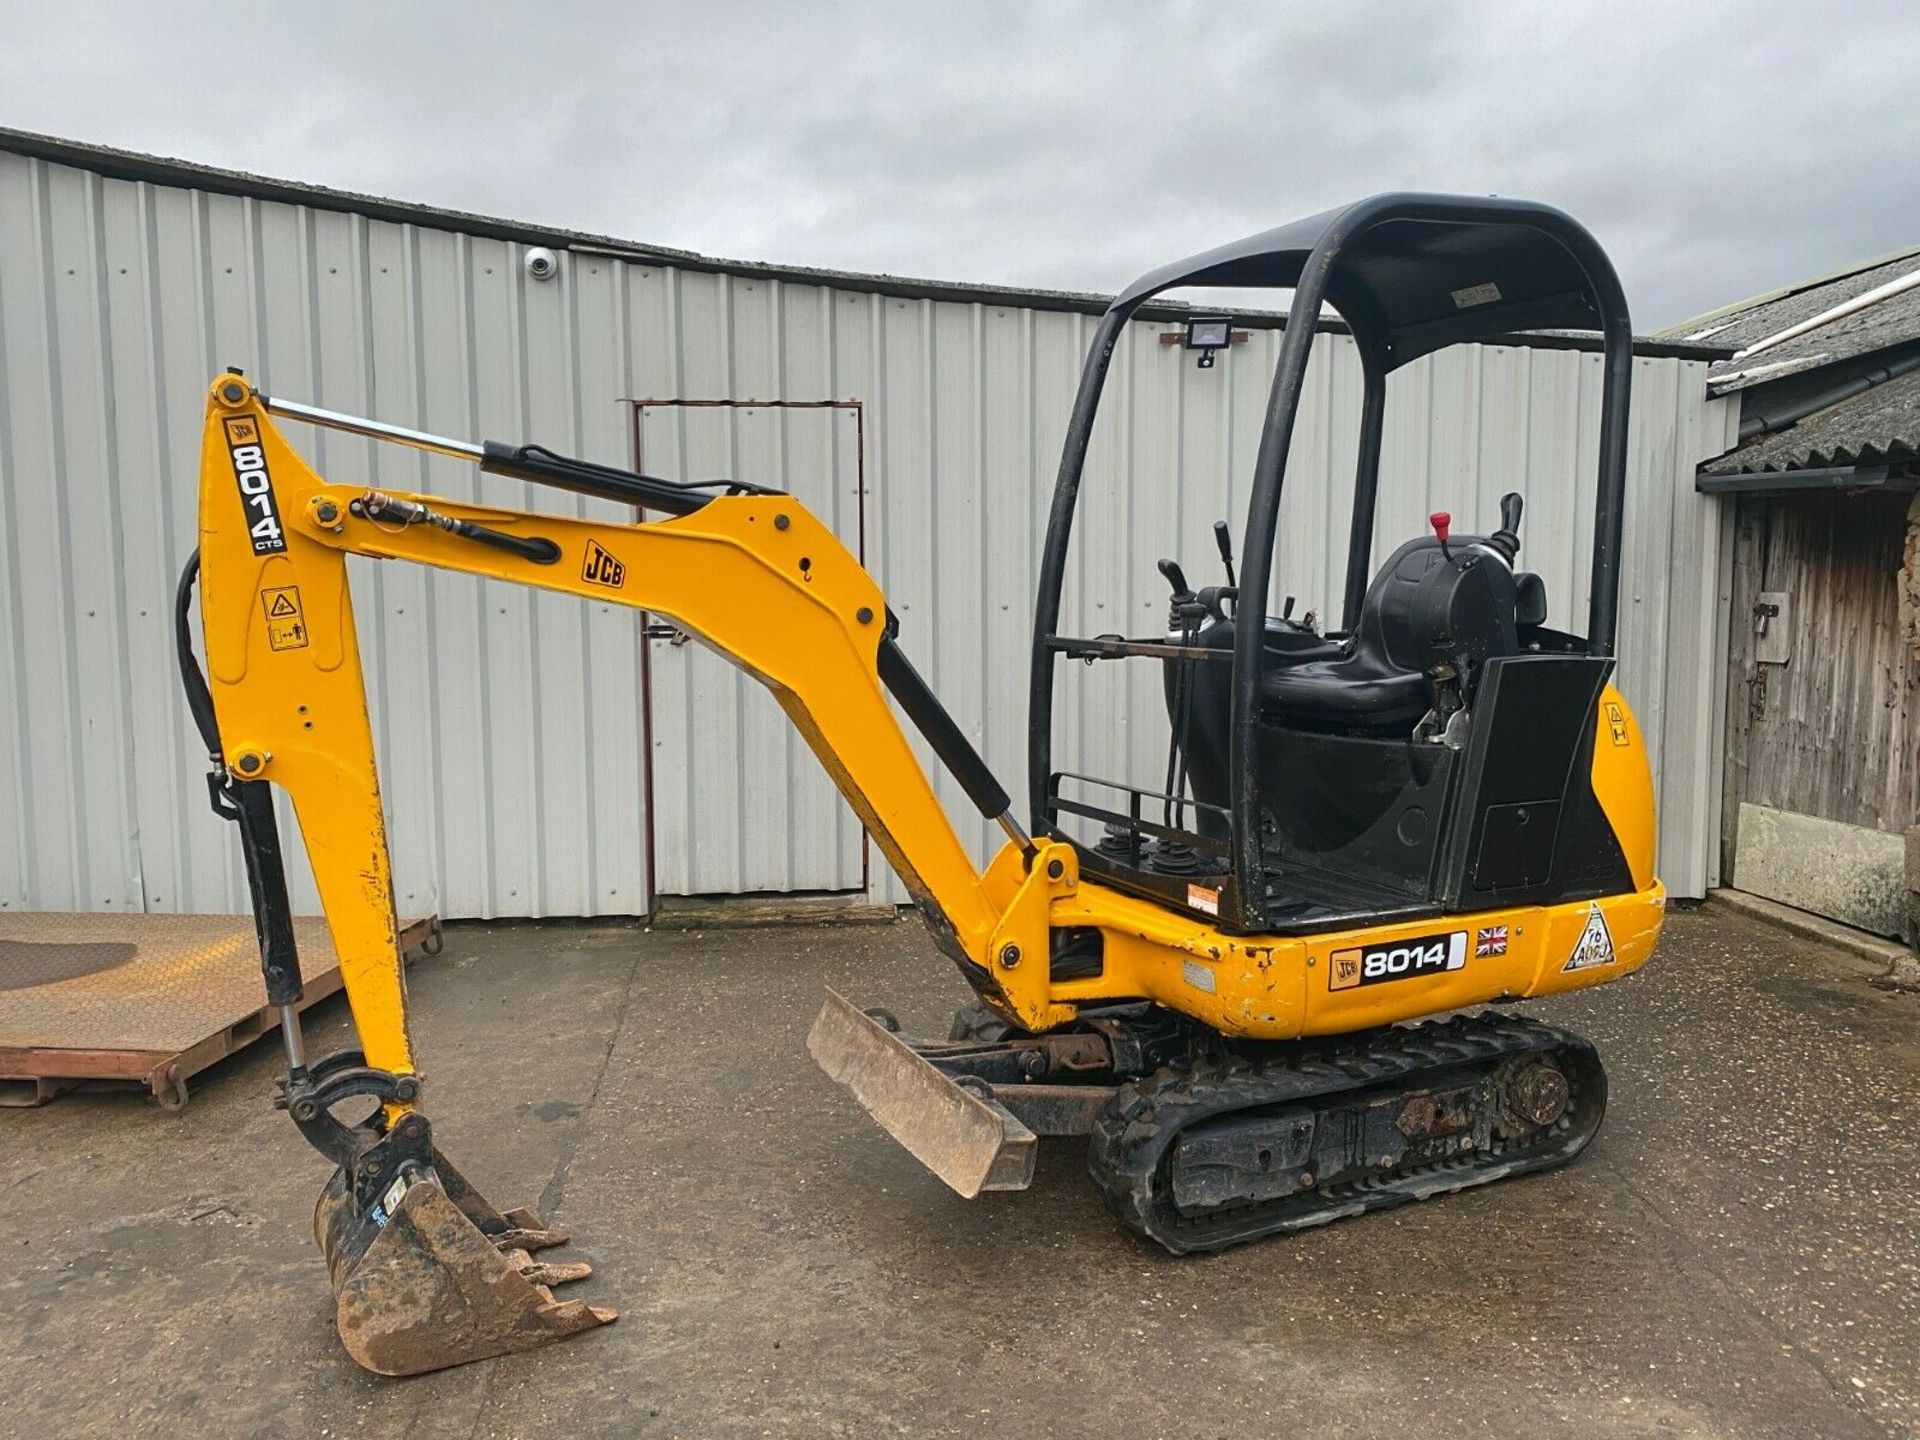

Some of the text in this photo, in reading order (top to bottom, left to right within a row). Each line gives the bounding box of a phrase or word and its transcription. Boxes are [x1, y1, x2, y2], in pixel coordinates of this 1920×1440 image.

[233, 446, 280, 539] 8014
[255, 539, 283, 550] CTS
[585, 546, 623, 586] JCB
[1364, 943, 1445, 978] 8014
